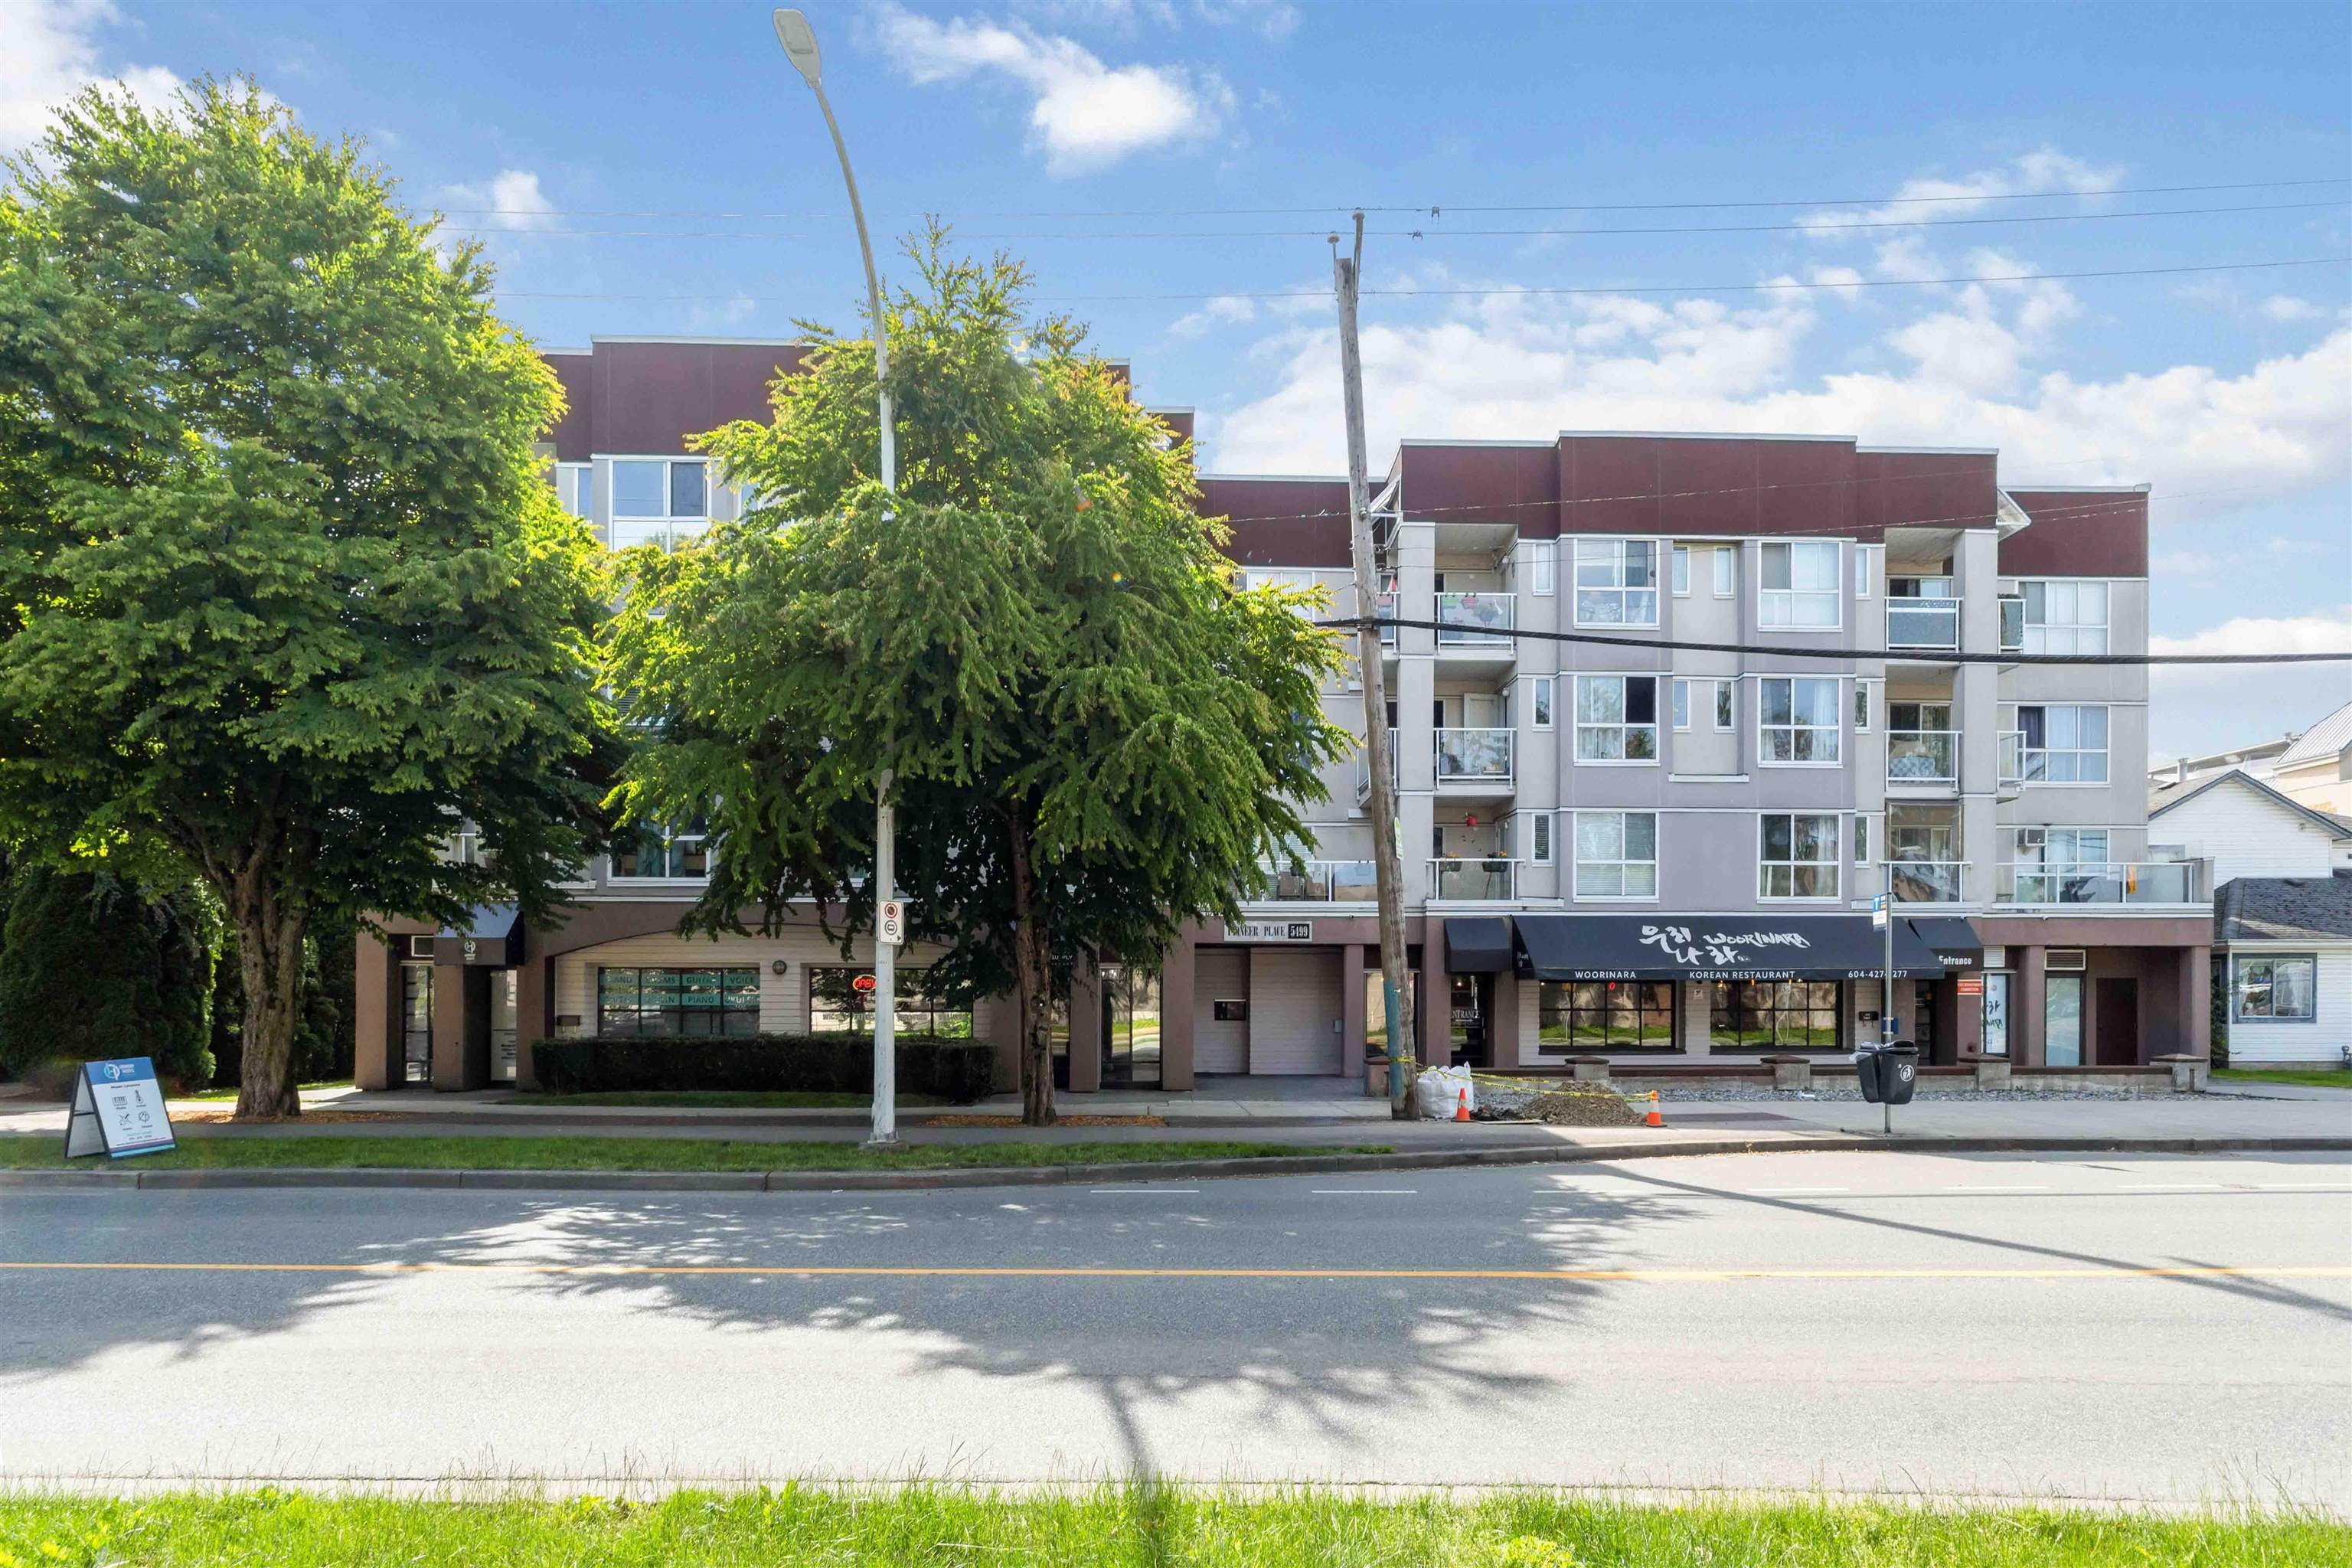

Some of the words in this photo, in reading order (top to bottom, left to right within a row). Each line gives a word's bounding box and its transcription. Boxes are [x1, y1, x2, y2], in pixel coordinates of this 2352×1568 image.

[1227, 926, 1258, 936] PNEER
[1264, 926, 1285, 936] PLACE
[1290, 925, 1308, 937] 5499
[1703, 932, 1811, 948] WOORINARA
